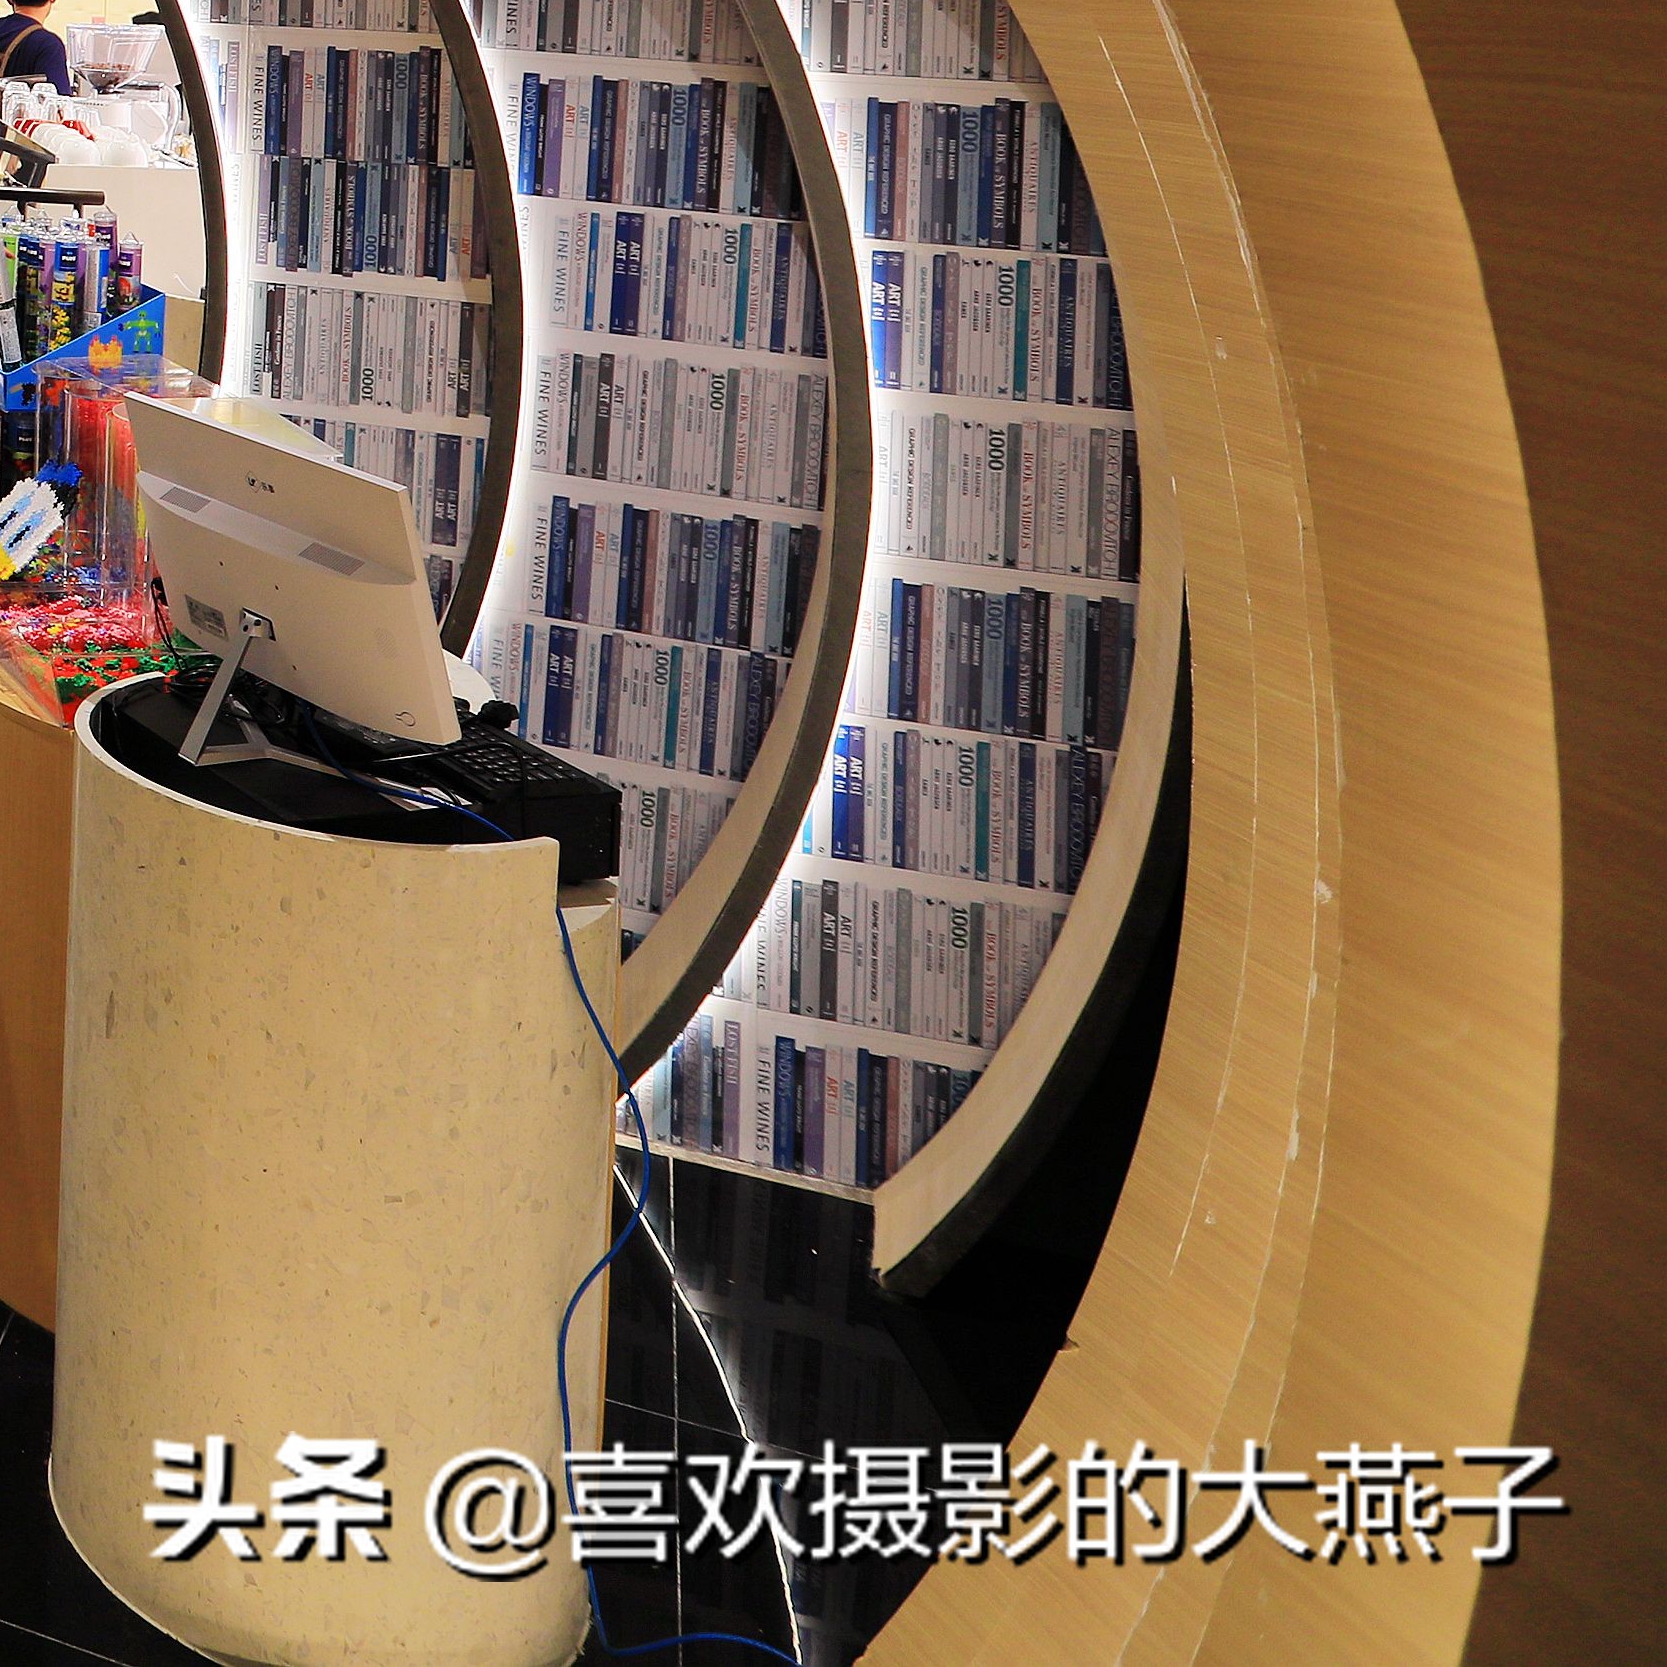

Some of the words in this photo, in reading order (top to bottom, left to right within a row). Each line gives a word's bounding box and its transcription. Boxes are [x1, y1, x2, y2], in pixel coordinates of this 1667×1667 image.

[254, 65, 265, 95] FINE
[252, 102, 264, 142] WINES
[992, 175, 1006, 229] SYMBOLS
[557, 230, 570, 262] FINE
[723, 228, 739, 264] 1000
[552, 267, 567, 314] WINES
[998, 265, 1014, 306] 1000
[361, 368, 375, 401] 1000
[540, 370, 552, 402] FINE
[710, 372, 726, 411] 1000
[534, 407, 549, 456] WINES
[536, 517, 549, 549] FINE
[530, 556, 546, 602] WINES
[655, 649, 670, 685] 1000
[951, 908, 968, 949] 1000
[759, 1059, 772, 1091] FINE
[755, 1097, 771, 1154] WINES
